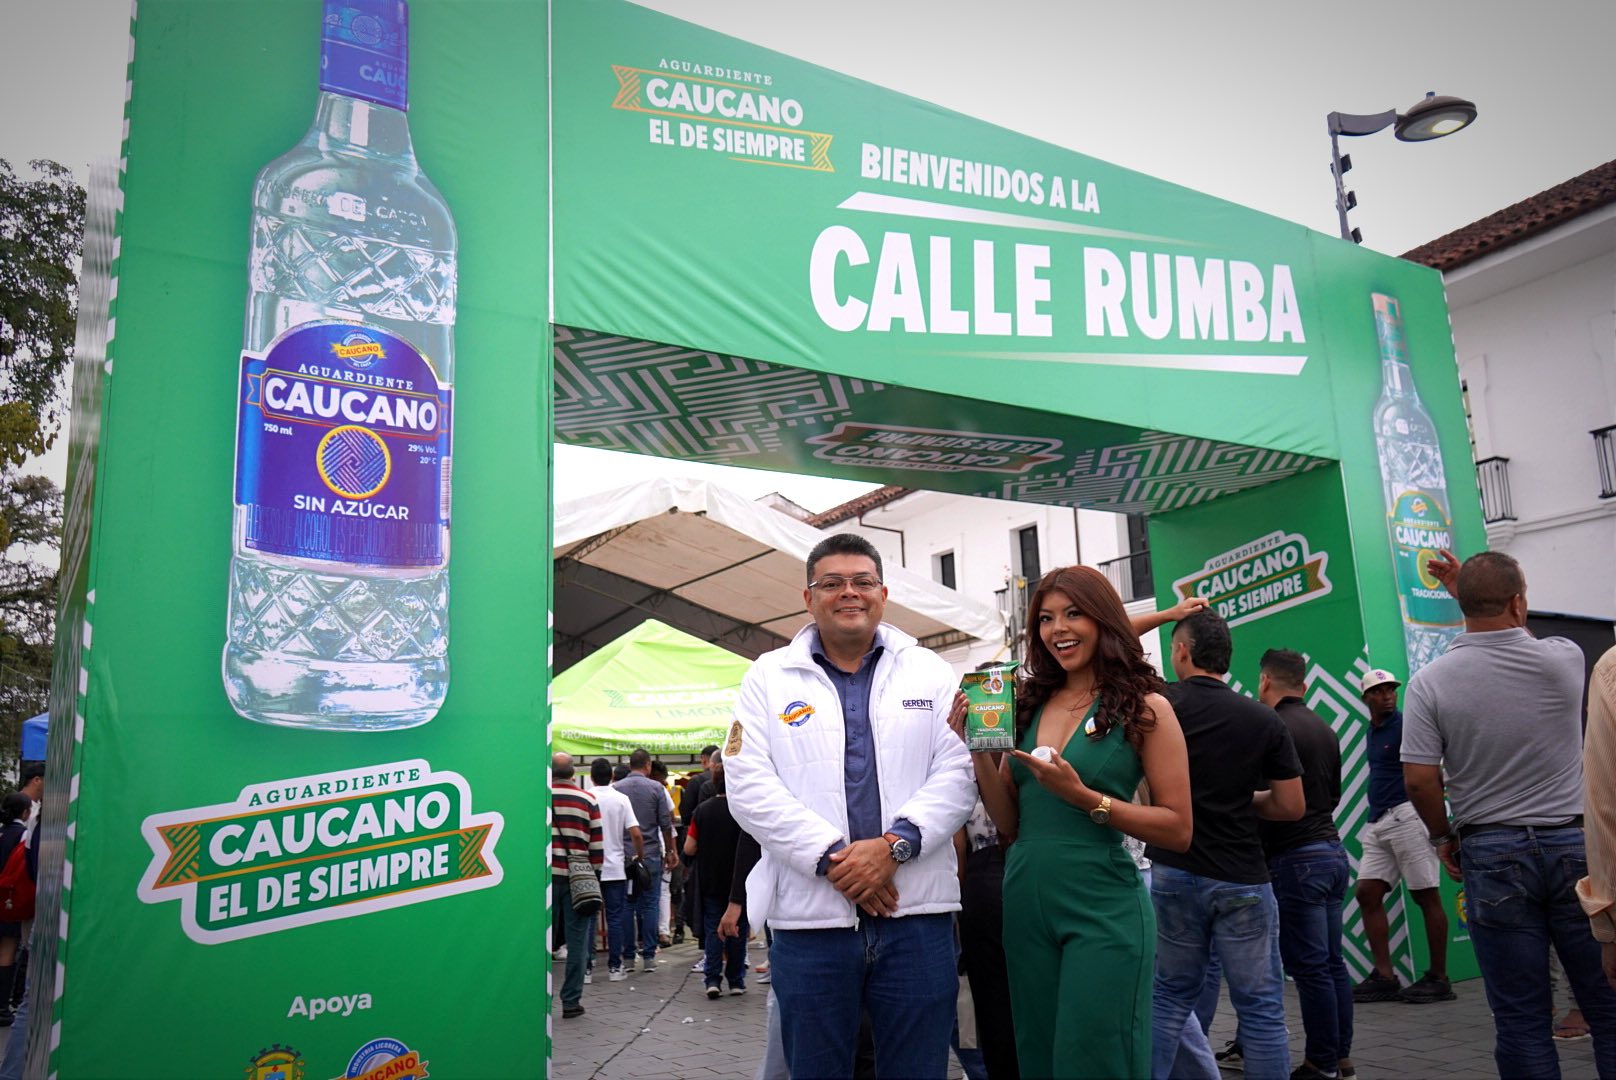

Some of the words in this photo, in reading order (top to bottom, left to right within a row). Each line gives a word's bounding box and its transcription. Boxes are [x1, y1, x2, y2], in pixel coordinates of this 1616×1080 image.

[658, 58, 773, 86] AGUARDIENTE
[646, 78, 804, 127] CAUCANO
[649, 118, 674, 145] EL
[680, 122, 708, 149] DE
[713, 127, 805, 161] SIEMPRE
[861, 142, 1045, 205] BIENVENIDOS
[1049, 176, 1067, 209] A
[1072, 180, 1100, 214] LA
[809, 225, 1053, 337] CALLE
[1084, 246, 1306, 344] RUMBA
[339, 345, 379, 356] CAUCANO
[298, 363, 414, 391] AGUARDIENTE
[265, 377, 437, 431] CAUCANO
[263, 422, 279, 433] 750
[280, 426, 293, 436] ml
[862, 431, 978, 449] SIEMPRE
[835, 444, 1010, 466] CAUCANO
[978, 440, 1011, 451] DE
[1013, 442, 1045, 454] EL
[294, 494, 325, 513] SIN
[331, 498, 409, 520] AZÚCAR
[1396, 526, 1450, 549] CAUCANO
[1209, 536, 1281, 571] AGUARDIENTE
[1197, 545, 1299, 599] CAUCANO
[1218, 598, 1237, 619] DE
[1238, 573, 1303, 613] SIEMPRE
[902, 699, 933, 709] GERENTE
[249, 768, 421, 807] AGUARDIENTE
[208, 791, 450, 867] CAUCANO
[209, 883, 248, 922] EL
[257, 871, 300, 913] DE
[307, 844, 449, 903] SIEMPRE
[287, 993, 373, 1020] Apoya
[351, 1046, 375, 1073] INDUSTRIA
